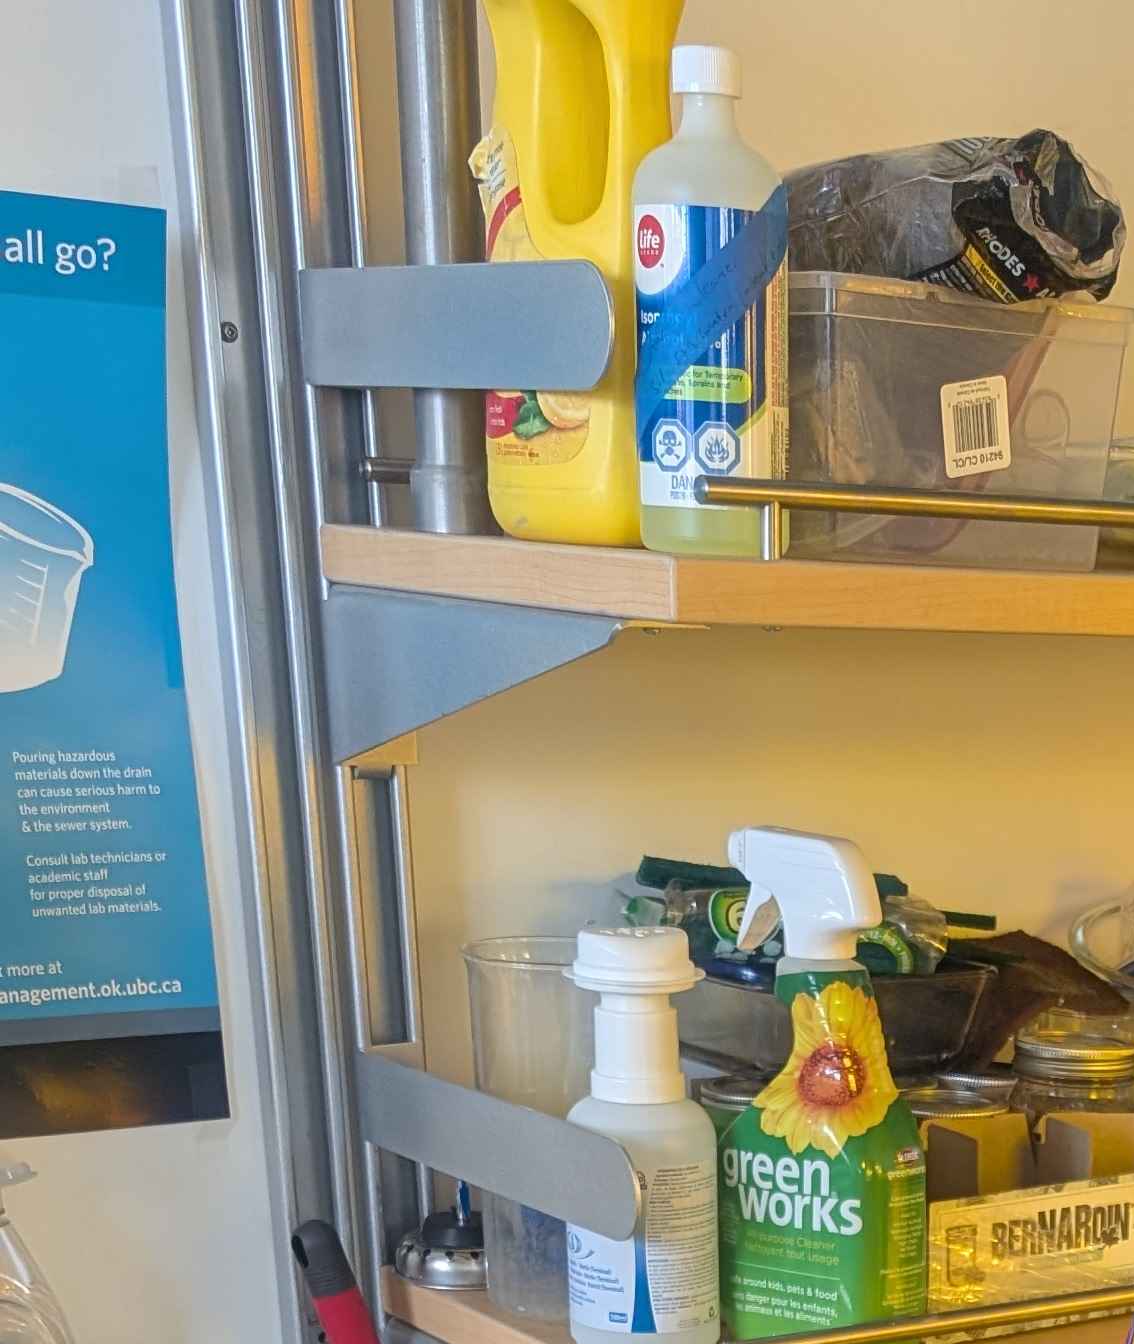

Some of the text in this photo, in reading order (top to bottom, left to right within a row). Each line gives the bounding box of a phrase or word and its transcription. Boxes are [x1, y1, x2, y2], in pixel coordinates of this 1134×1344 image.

[5, 229, 117, 275] all go?
[12, 750, 116, 765] Pouring hazardous
[15, 766, 152, 781] materials down the drain
[17, 783, 161, 798] can cause serious harm to
[19, 802, 110, 816] the environment
[21, 819, 133, 833] & the sewer system.
[26, 851, 168, 867] Consult lab technicians or
[28, 868, 109, 884] academic staff
[30, 883, 146, 902] for proper disposal of
[32, 901, 163, 917] unwanted lab materials.
[7, 960, 64, 977] more at
[723, 1148, 830, 1197] green
[738, 1184, 864, 1236] works
[991, 1201, 1131, 1260] BERNARDIN
[814, 1287, 838, 1302] food
